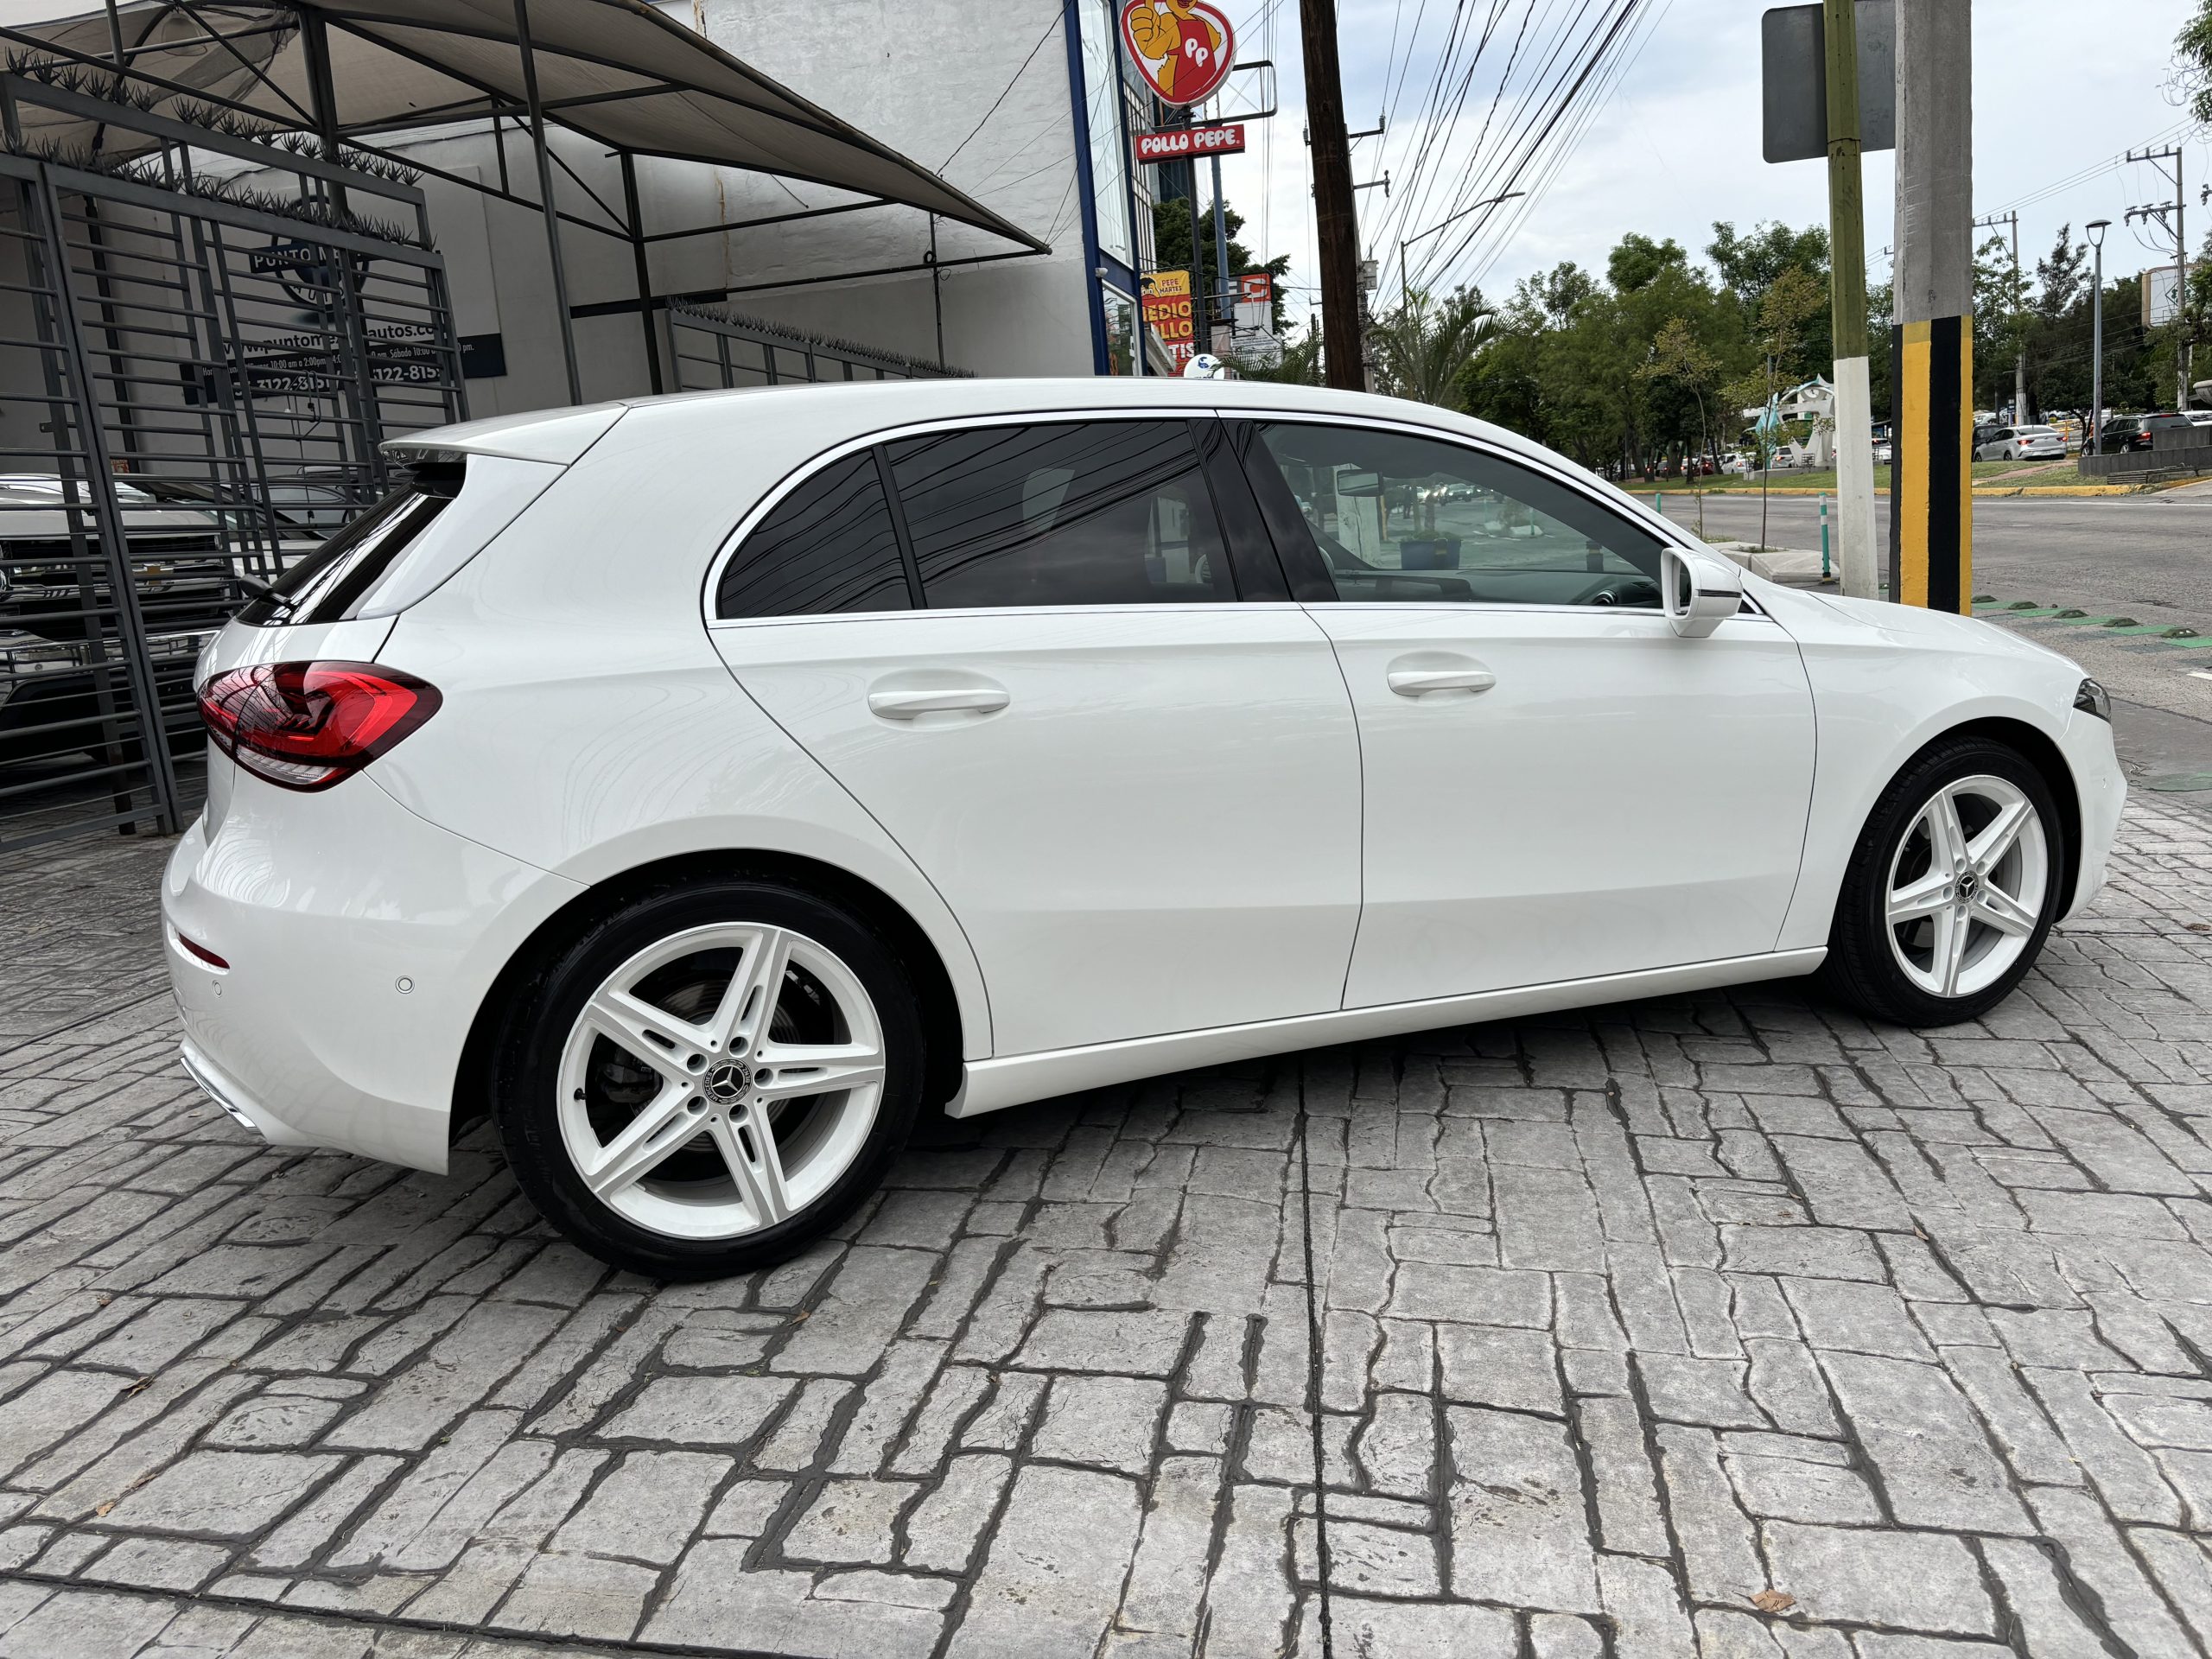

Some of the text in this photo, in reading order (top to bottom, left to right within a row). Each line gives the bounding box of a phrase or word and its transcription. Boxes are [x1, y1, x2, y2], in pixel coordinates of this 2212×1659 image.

[1141, 128, 1236, 155] POLLO PEPE
[254, 248, 311, 269] PUNTO
[1159, 285, 1183, 294] MARTES
[1161, 278, 1179, 287] PEPE
[1159, 320, 1193, 340] LLO
[390, 347, 412, 359] Sábado
[704, 1067, 751, 1102] MERCEDES BENZ
